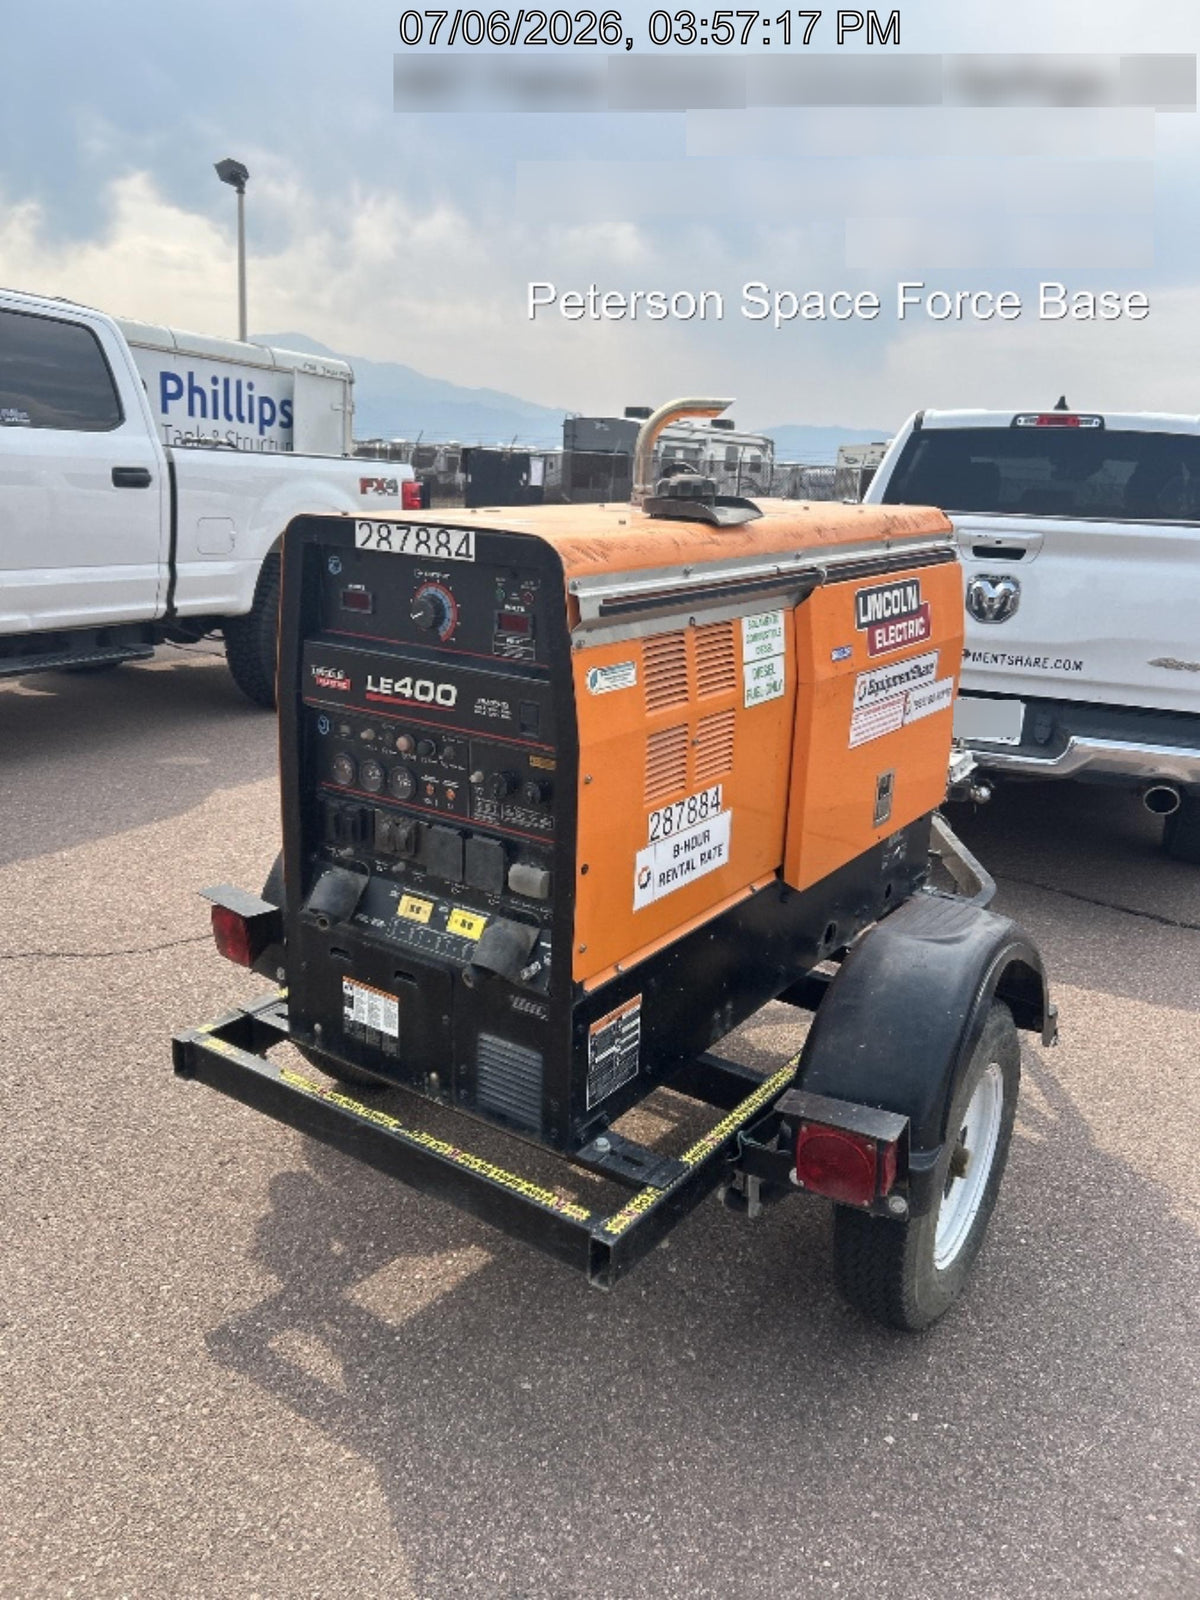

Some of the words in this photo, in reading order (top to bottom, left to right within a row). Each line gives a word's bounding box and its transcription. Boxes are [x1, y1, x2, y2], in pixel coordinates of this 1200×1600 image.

[160, 371, 293, 435] Phillips
[360, 477, 399, 496] FX4
[357, 521, 474, 560] 287884
[858, 584, 919, 624] LINCOLN
[875, 616, 926, 650] ELECTRIC
[366, 675, 457, 706] LE400
[649, 785, 721, 842] 287884
[658, 857, 697, 888] RENTAL
[700, 842, 725, 866] RATE
